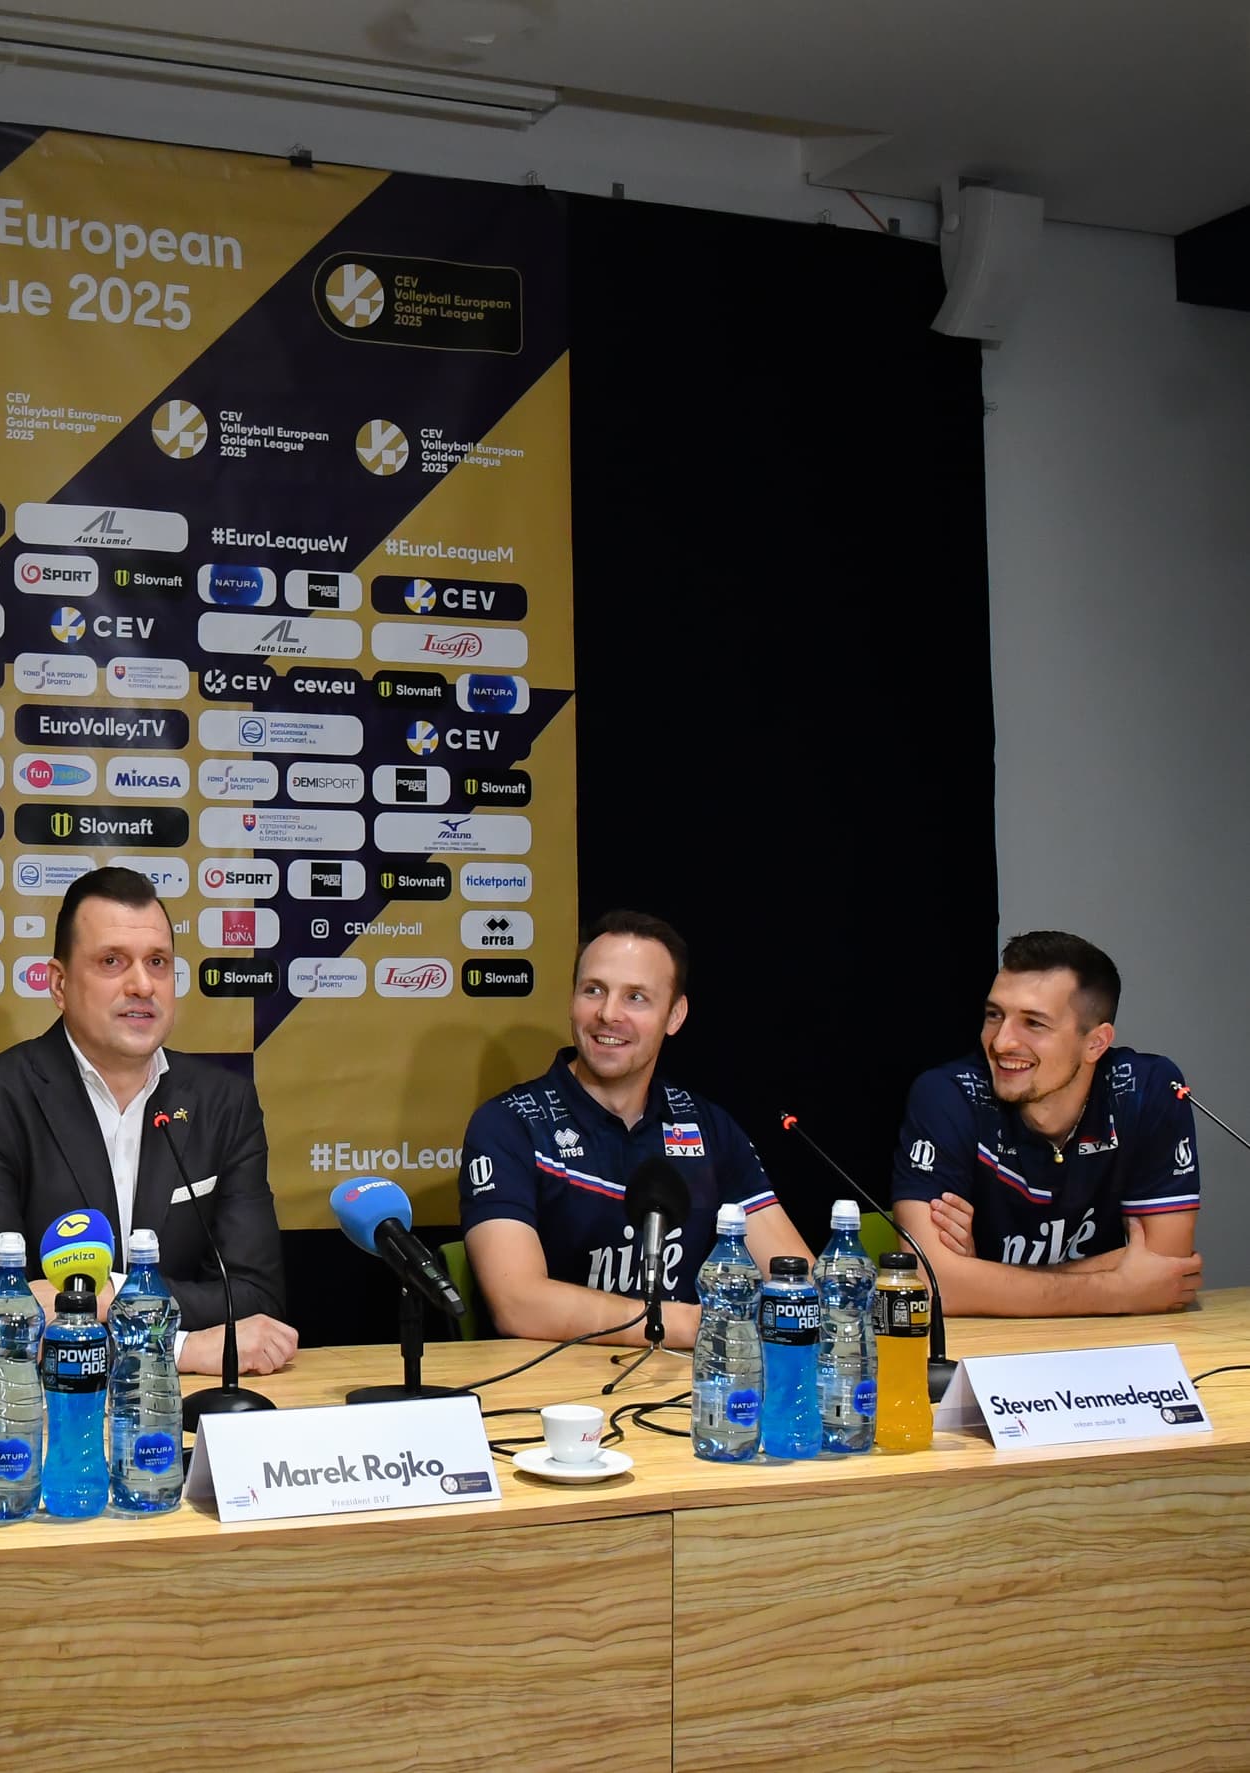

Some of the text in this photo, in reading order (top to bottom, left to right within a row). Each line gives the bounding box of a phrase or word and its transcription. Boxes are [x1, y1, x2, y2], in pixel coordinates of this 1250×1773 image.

[394, 275, 419, 288] CEV
[67, 273, 191, 331] 2025
[394, 289, 511, 310] Volleyball European
[394, 302, 485, 322] Golden League
[393, 314, 422, 327] 2025
[219, 410, 243, 422] CEV
[220, 422, 329, 442] Volleyball European
[420, 428, 443, 439] CEV
[220, 434, 304, 452] Golden League
[420, 439, 524, 457] Volleyball European
[219, 446, 247, 458] 2025
[421, 451, 501, 468] Golden League
[421, 462, 448, 473] 2025
[74, 535, 132, 546] Auto Lamač
[211, 527, 348, 554] #EuroLeagueW
[385, 538, 514, 565] #EuroLeagueM
[42, 566, 92, 583] ŠPORT
[215, 578, 258, 588] NATURA
[442, 588, 496, 611] CEV
[93, 615, 155, 640] CEV
[473, 687, 513, 697] NATURA
[445, 729, 500, 751] CEV
[481, 782, 526, 795] Slovnaft
[79, 817, 153, 835] Slovnaft
[225, 871, 273, 885] ŠPORT
[398, 875, 445, 888] Slovnaft
[466, 874, 527, 889] ticketportal
[224, 931, 254, 943] RONA
[344, 922, 422, 937] CEVolleyball
[485, 971, 528, 985] Slovnaft
[310, 1140, 463, 1172] #EuroLea
[665, 1145, 703, 1157] SVK
[588, 1225, 683, 1293] nié
[775, 1303, 819, 1317] POWER
[799, 1316, 821, 1329] ADE
[57, 1347, 106, 1362] POWER
[80, 1360, 107, 1375] ADE
[990, 1381, 1190, 1418] Steven Venmedegael
[139, 1445, 172, 1455] NATURA
[263, 1455, 360, 1489] Marek
[362, 1450, 444, 1488] Rojko
